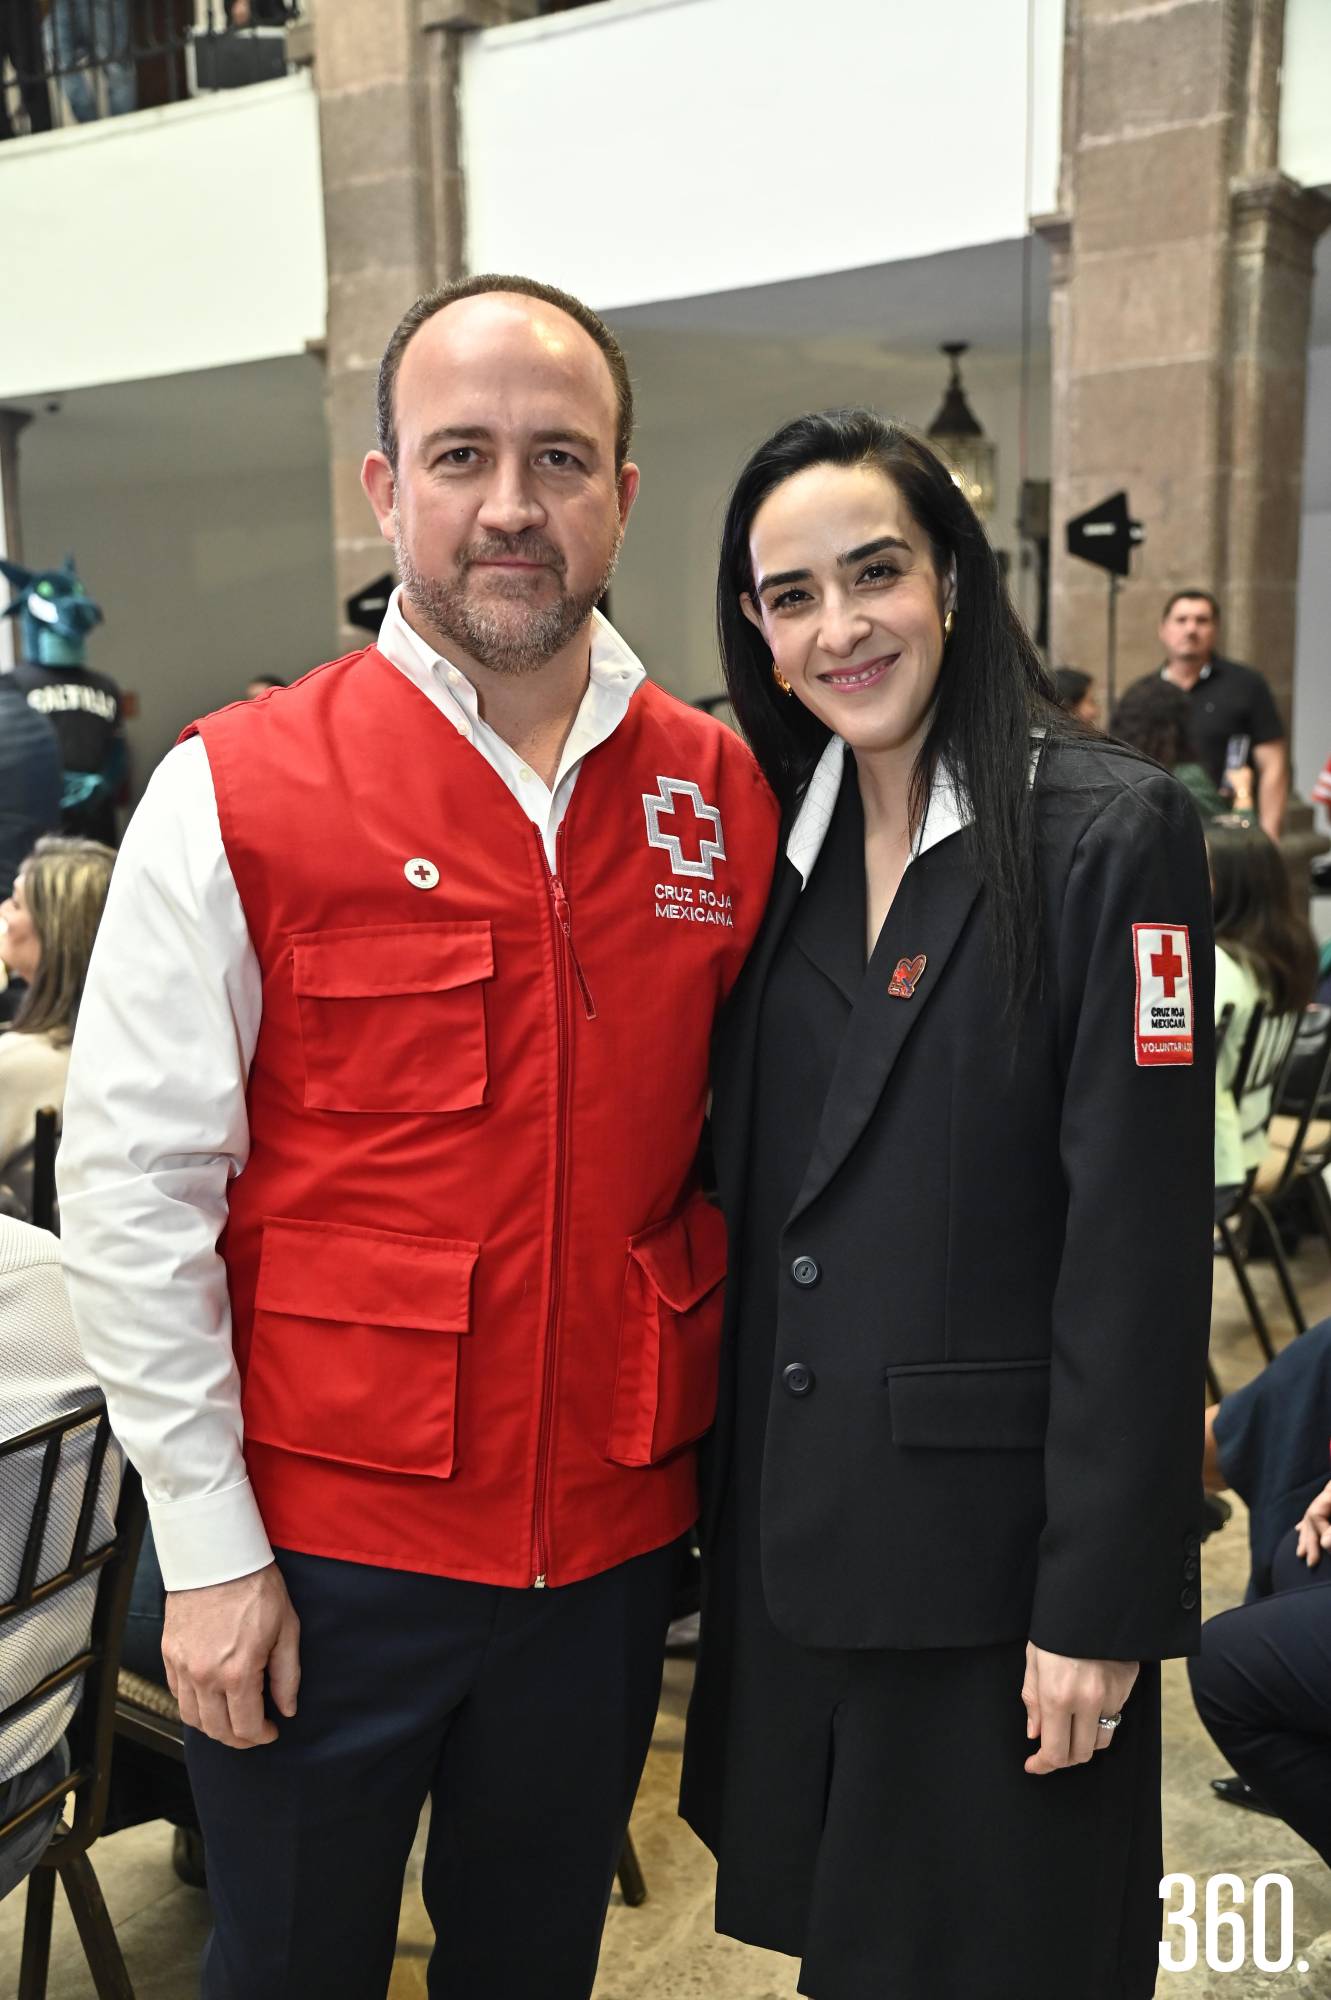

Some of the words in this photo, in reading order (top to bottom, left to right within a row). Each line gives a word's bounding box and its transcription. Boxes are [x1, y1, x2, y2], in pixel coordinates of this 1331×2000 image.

[654, 883, 694, 903] CRUZ
[699, 889, 733, 910] ROJA
[655, 902, 734, 929] MEXICANA
[1151, 1007, 1170, 1017] CRUZ
[1170, 1007, 1185, 1017] ROJA
[1151, 1018, 1185, 1028] MEXICANA
